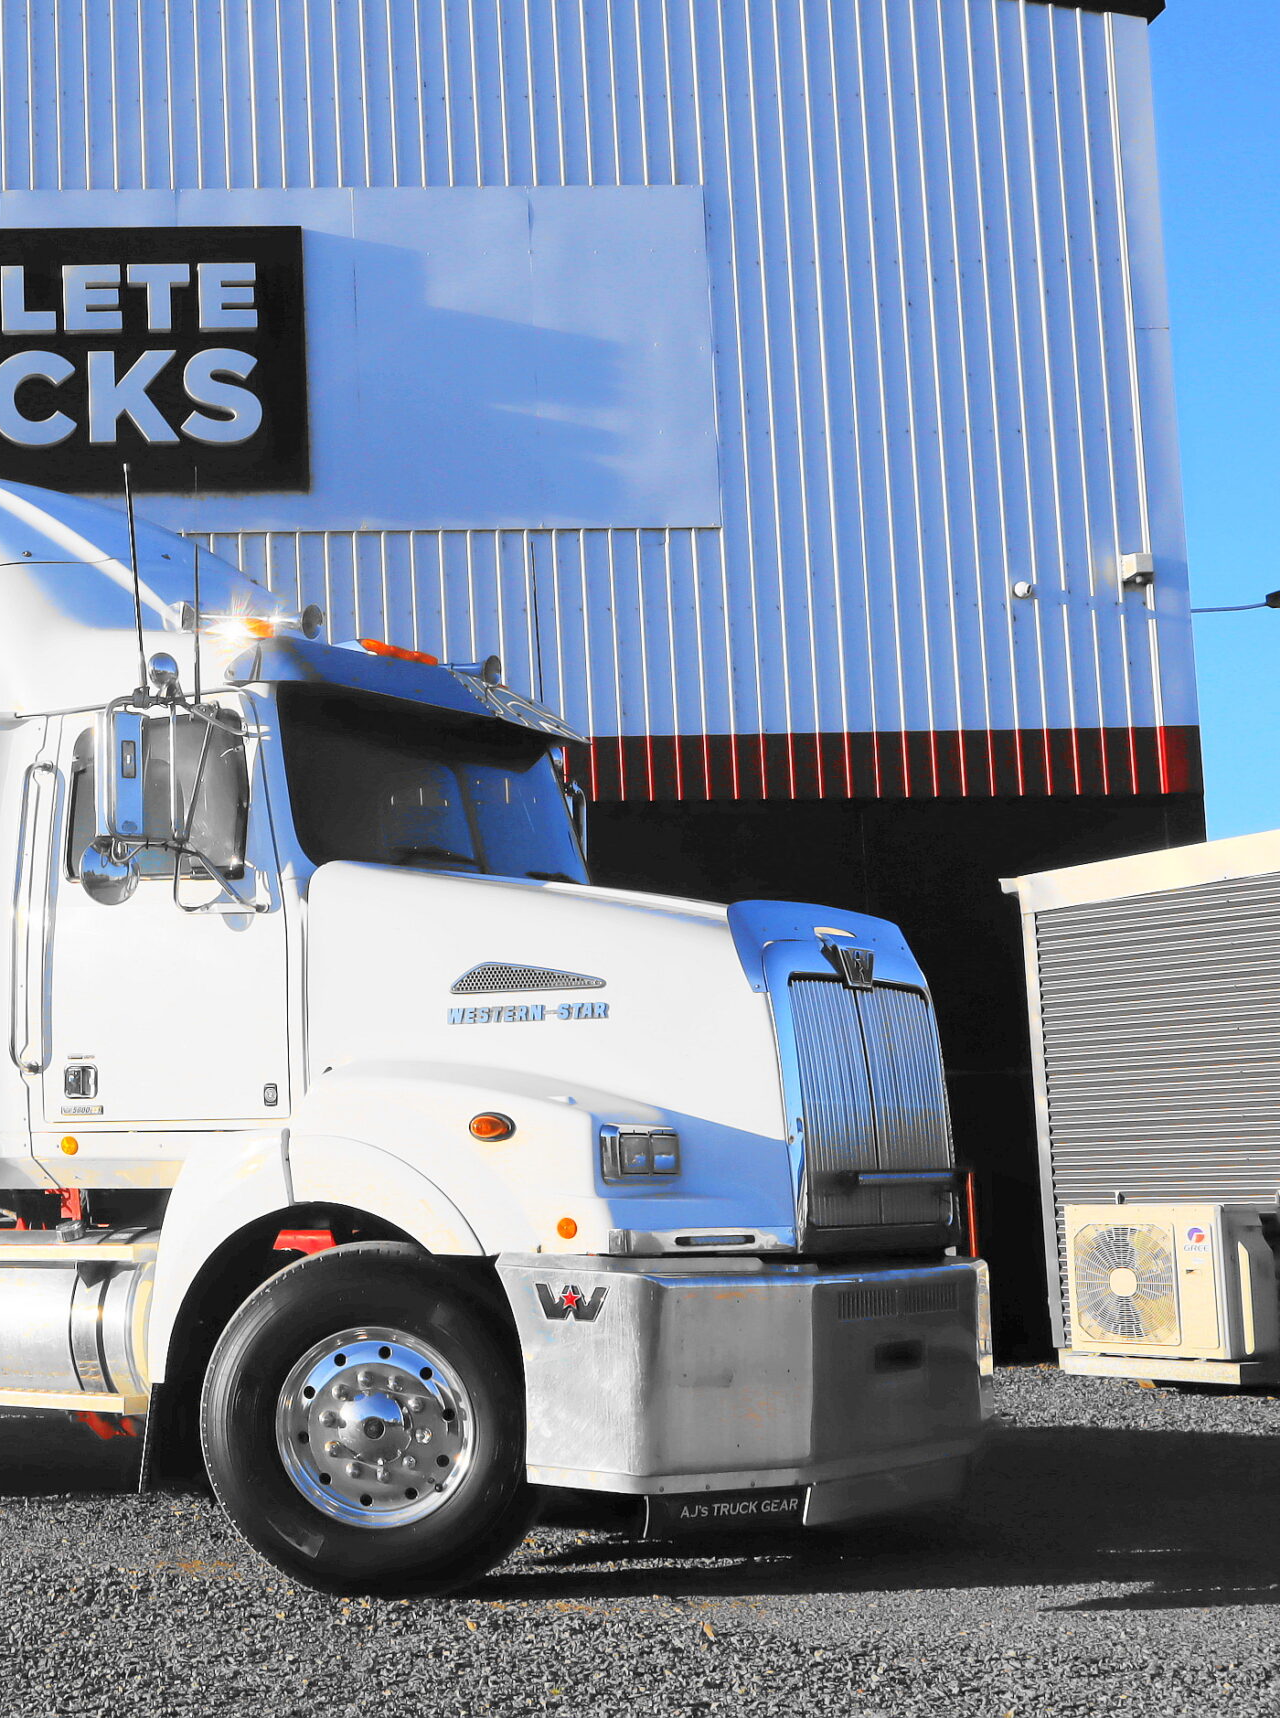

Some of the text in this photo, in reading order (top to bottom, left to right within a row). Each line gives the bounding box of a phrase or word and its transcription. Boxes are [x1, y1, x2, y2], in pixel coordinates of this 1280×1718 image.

[680, 1498, 799, 1519] AJ's TRUCK GEAR
